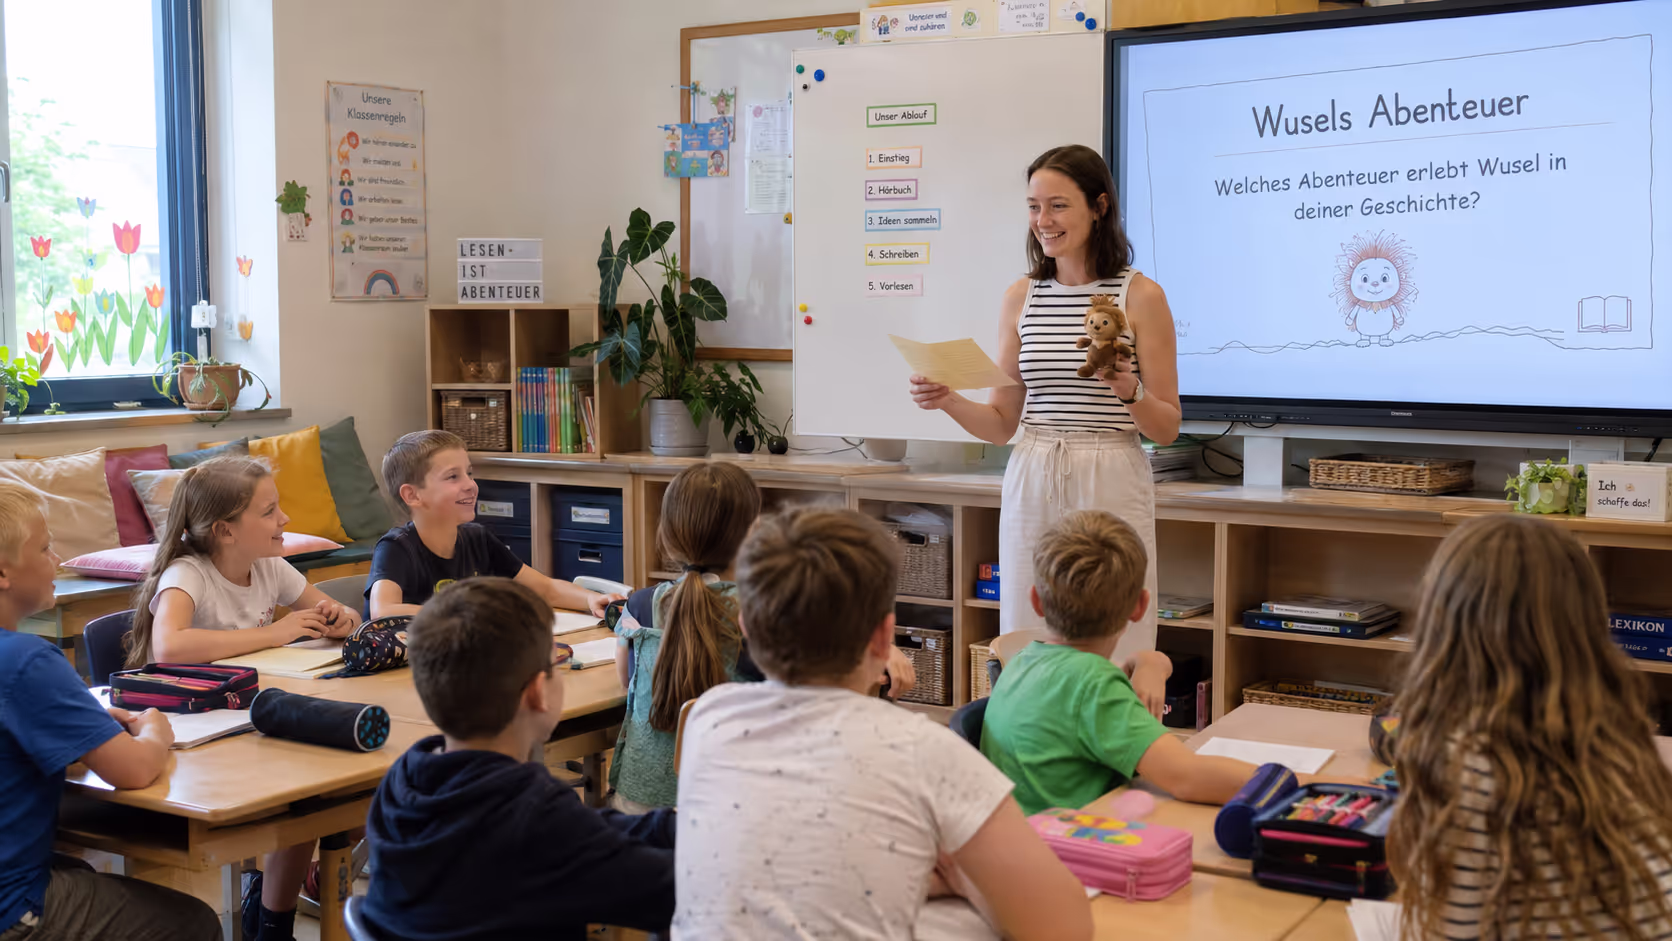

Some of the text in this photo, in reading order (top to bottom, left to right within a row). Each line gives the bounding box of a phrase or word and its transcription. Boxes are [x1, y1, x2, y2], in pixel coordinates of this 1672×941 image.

[362, 92, 392, 105] Unsere
[875, 112, 898, 121] Unser
[1252, 88, 1529, 138] Wusels Abenteuer
[868, 153, 910, 164] 1. Einstieg
[1215, 153, 1567, 196] Welches Abenteuer erlebt Wusel in
[868, 185, 912, 195] 2. Hörbuch
[1294, 191, 1481, 220] deiner Geschichte?
[867, 217, 875, 226] 3.
[878, 217, 902, 226] Ideen
[460, 243, 505, 257] LESEN
[868, 249, 919, 259] 4. Schreiben
[462, 265, 486, 278] IST
[461, 286, 541, 299] ABENTEUER
[868, 281, 914, 291] 5. Vorlesen
[1598, 480, 1617, 491] Ich
[1608, 618, 1665, 633] LEXIKON
